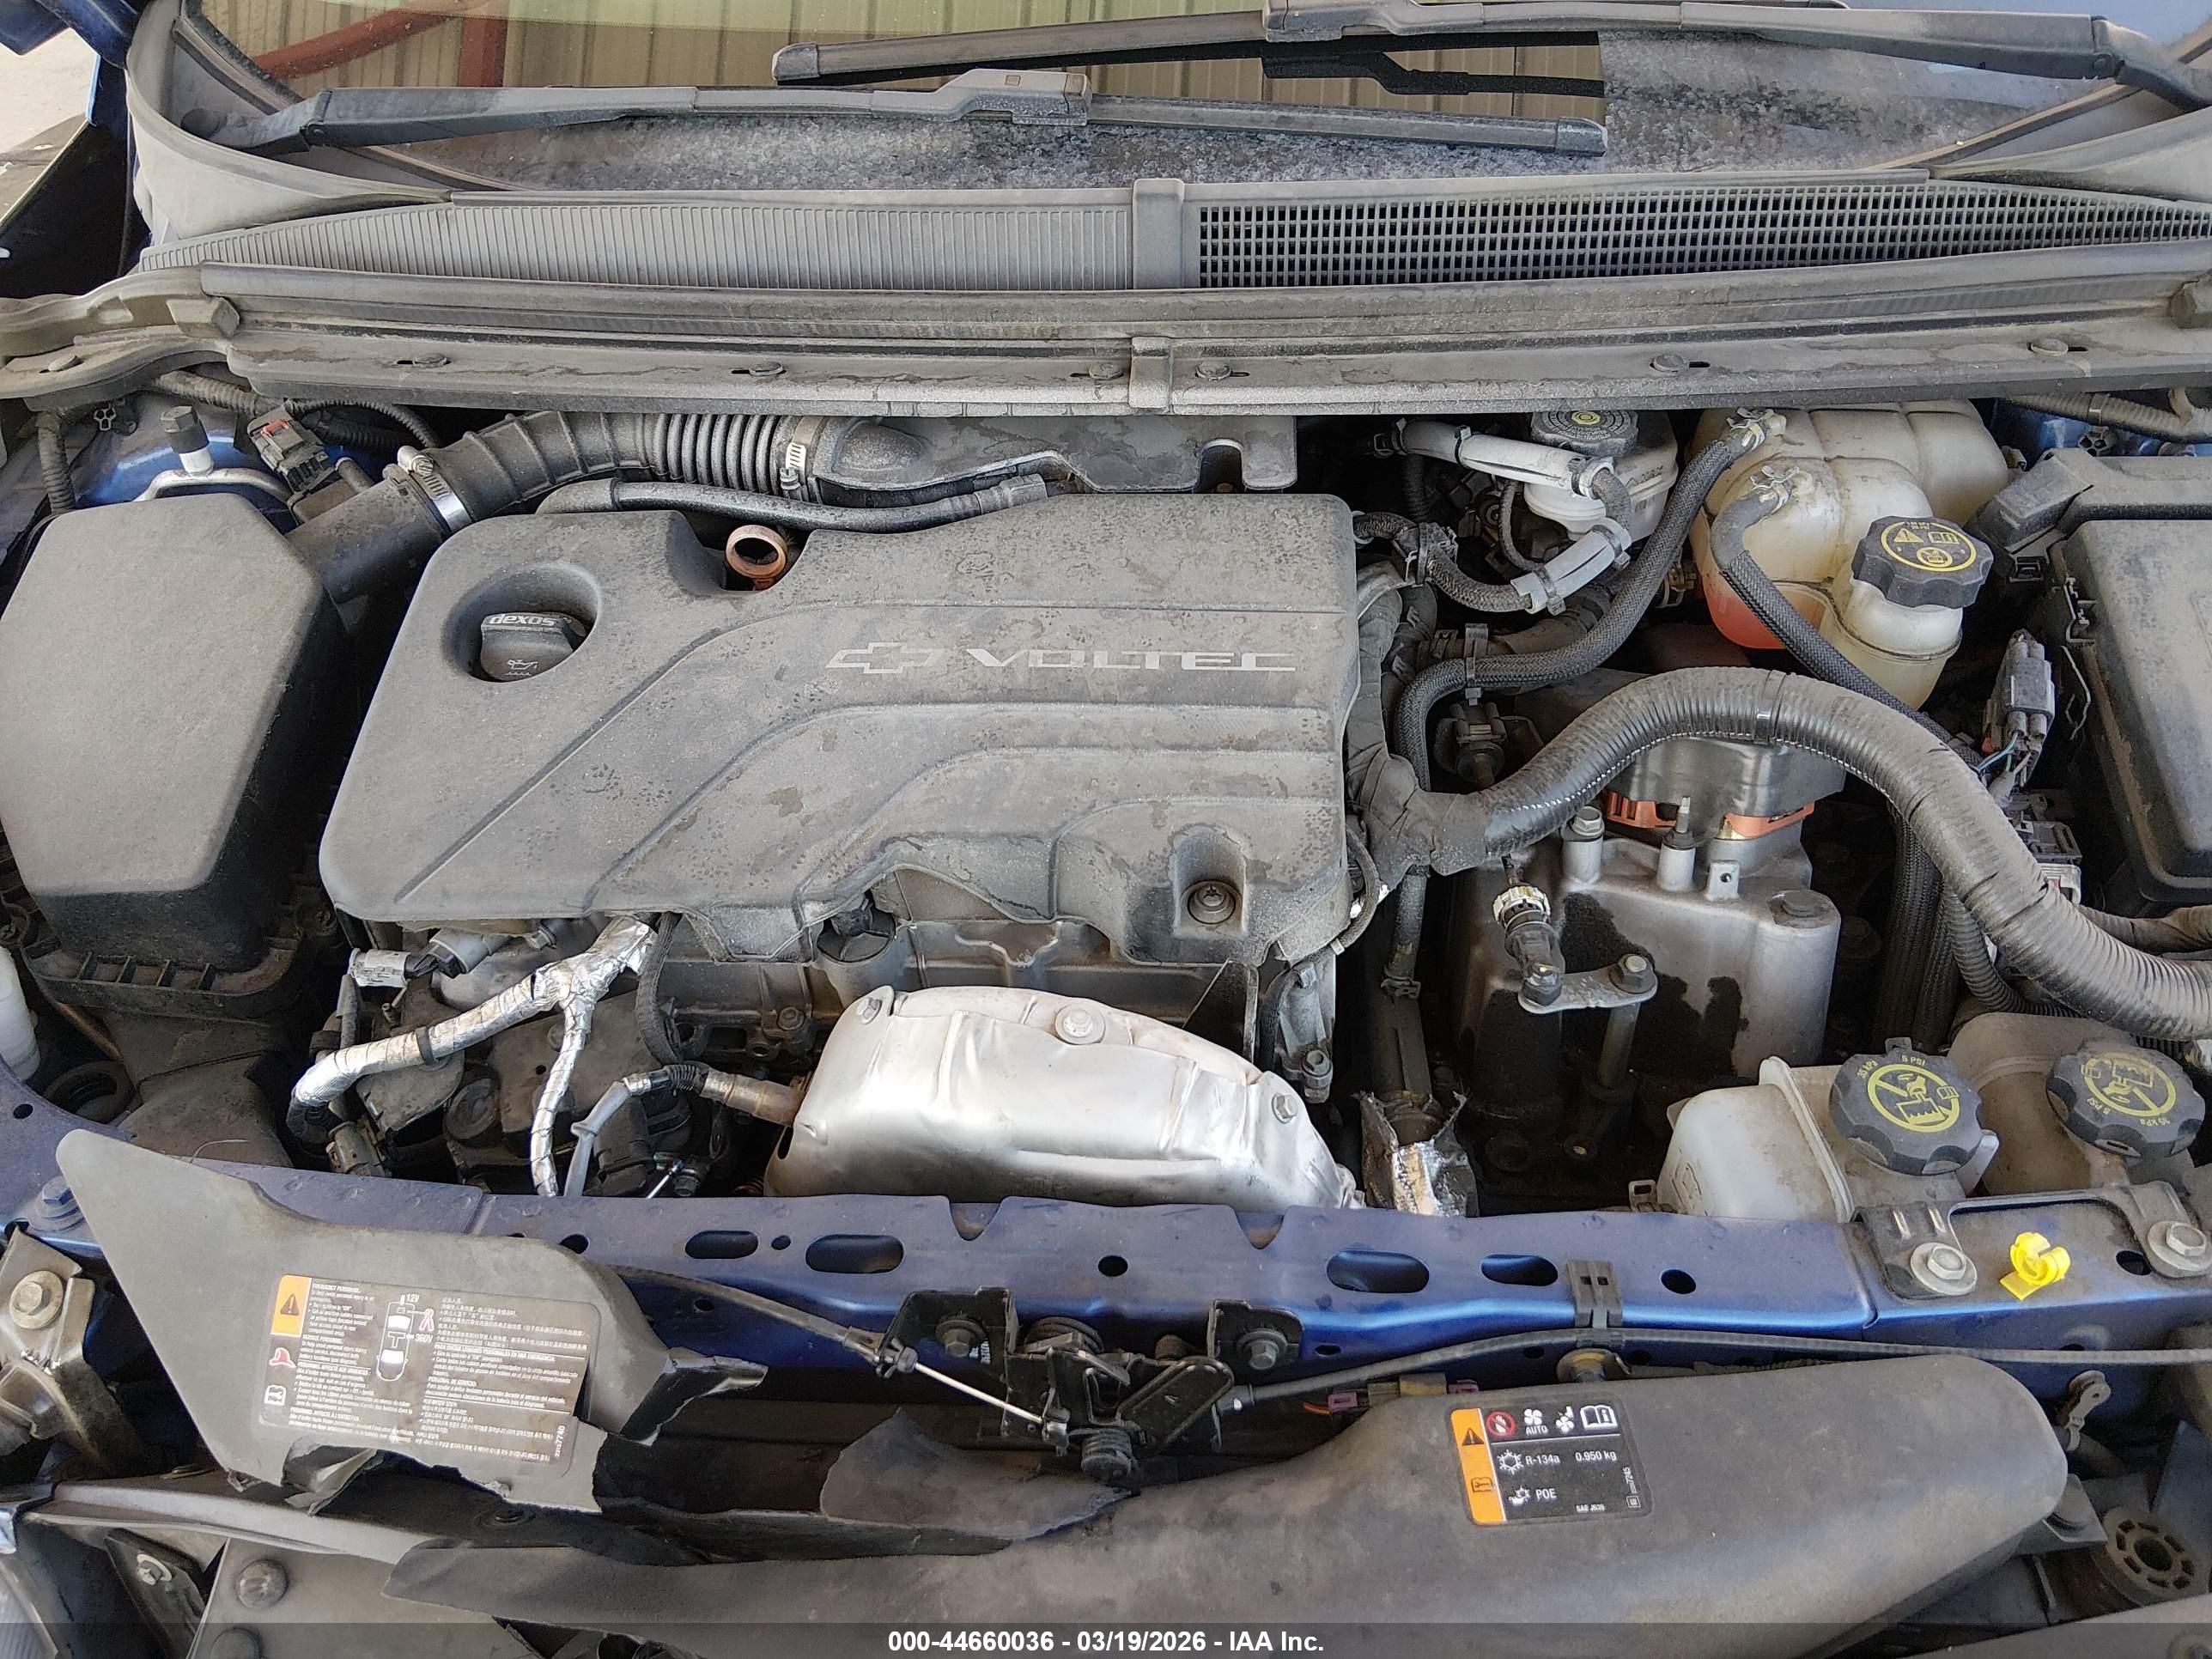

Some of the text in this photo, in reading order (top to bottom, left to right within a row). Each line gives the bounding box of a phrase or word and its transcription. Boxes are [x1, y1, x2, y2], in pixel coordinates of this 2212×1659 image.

[489, 614, 558, 627] dexos
[965, 649, 1297, 672] VOLTEC
[1910, 1056, 1926, 1066] PSI
[2087, 1097, 2104, 1111] PSI
[406, 1293, 420, 1303] 12V
[416, 1334, 434, 1344] 360V
[1525, 1425, 1548, 1435] AUTO
[1525, 1454, 1560, 1465] R-134a
[1575, 1449, 1618, 1462] 0.950 kg
[1535, 1488, 1558, 1500] POE
